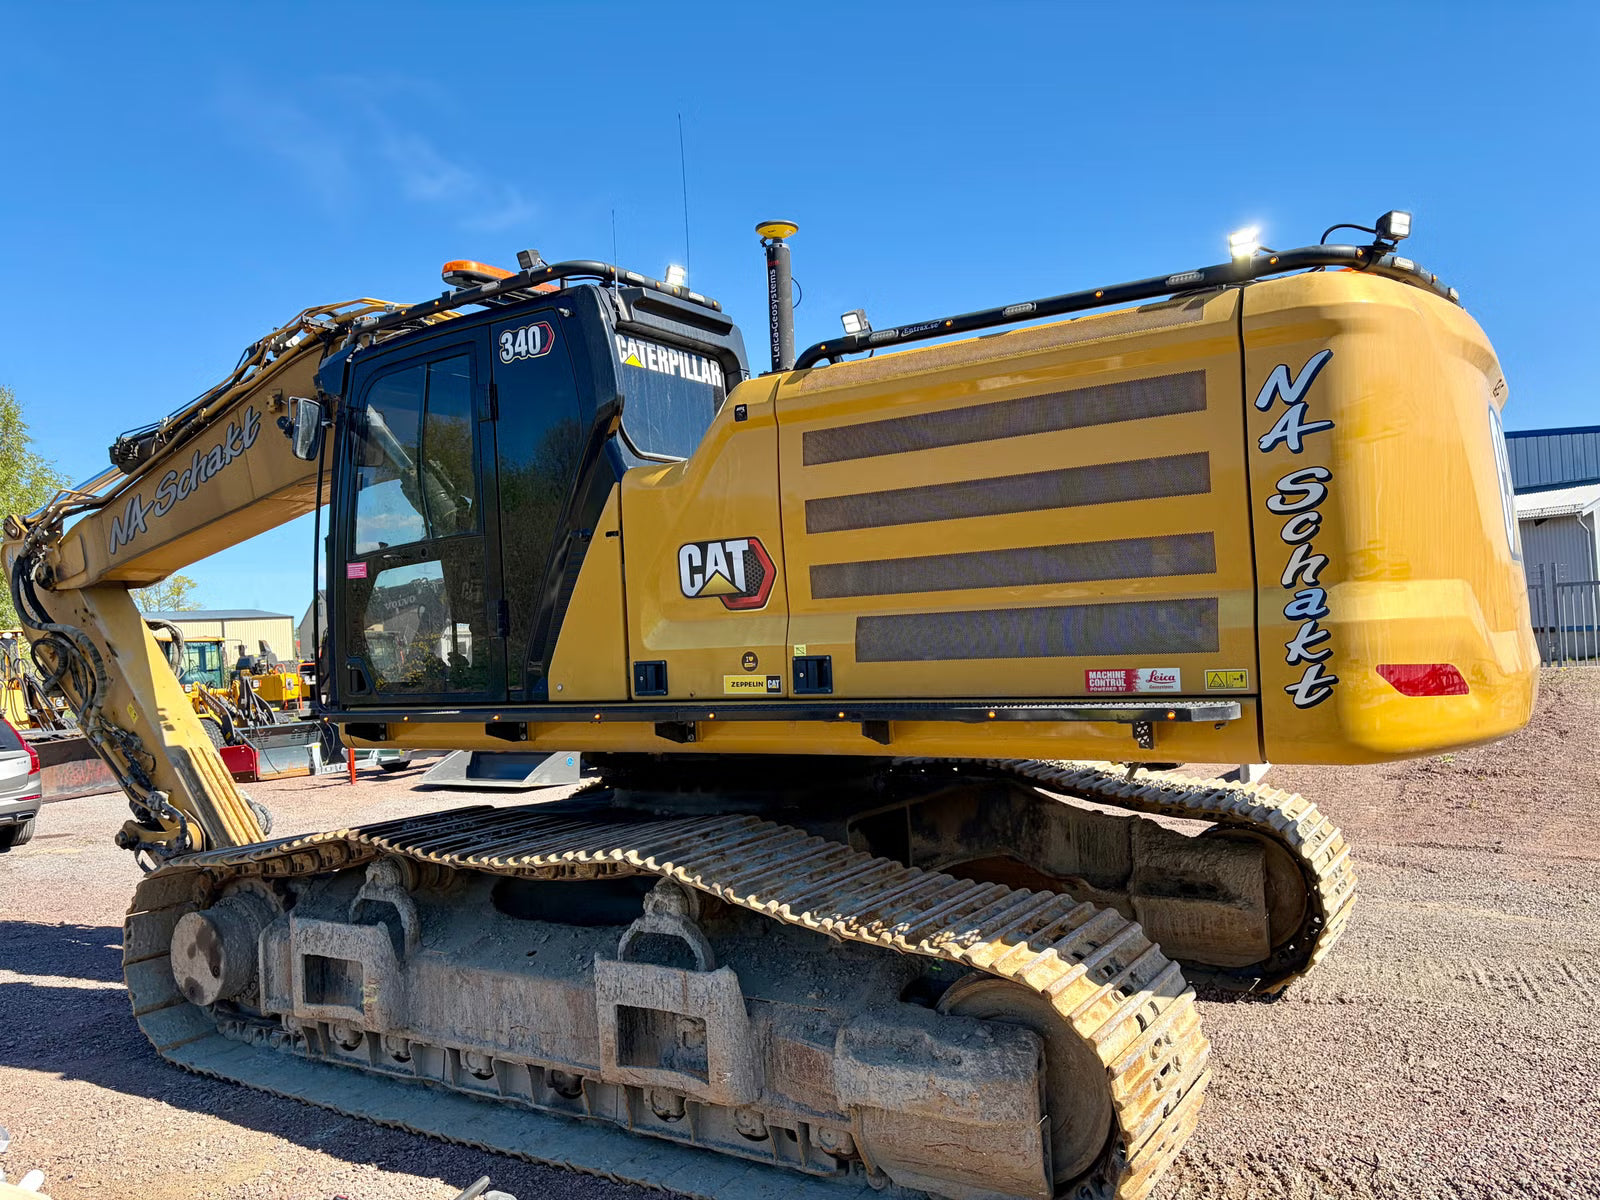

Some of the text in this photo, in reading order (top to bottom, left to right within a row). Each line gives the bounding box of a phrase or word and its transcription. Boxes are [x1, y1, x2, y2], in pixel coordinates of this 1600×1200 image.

[501, 326, 541, 361] 340
[615, 334, 722, 387] CATERPILLAR
[679, 540, 748, 596] CAT
[1265, 466, 1340, 709] Schakt
[767, 679, 780, 689] CAT
[1089, 671, 1126, 679] MACHINE
[1089, 679, 1126, 687] CONTROL
[1146, 669, 1176, 684] Leica
